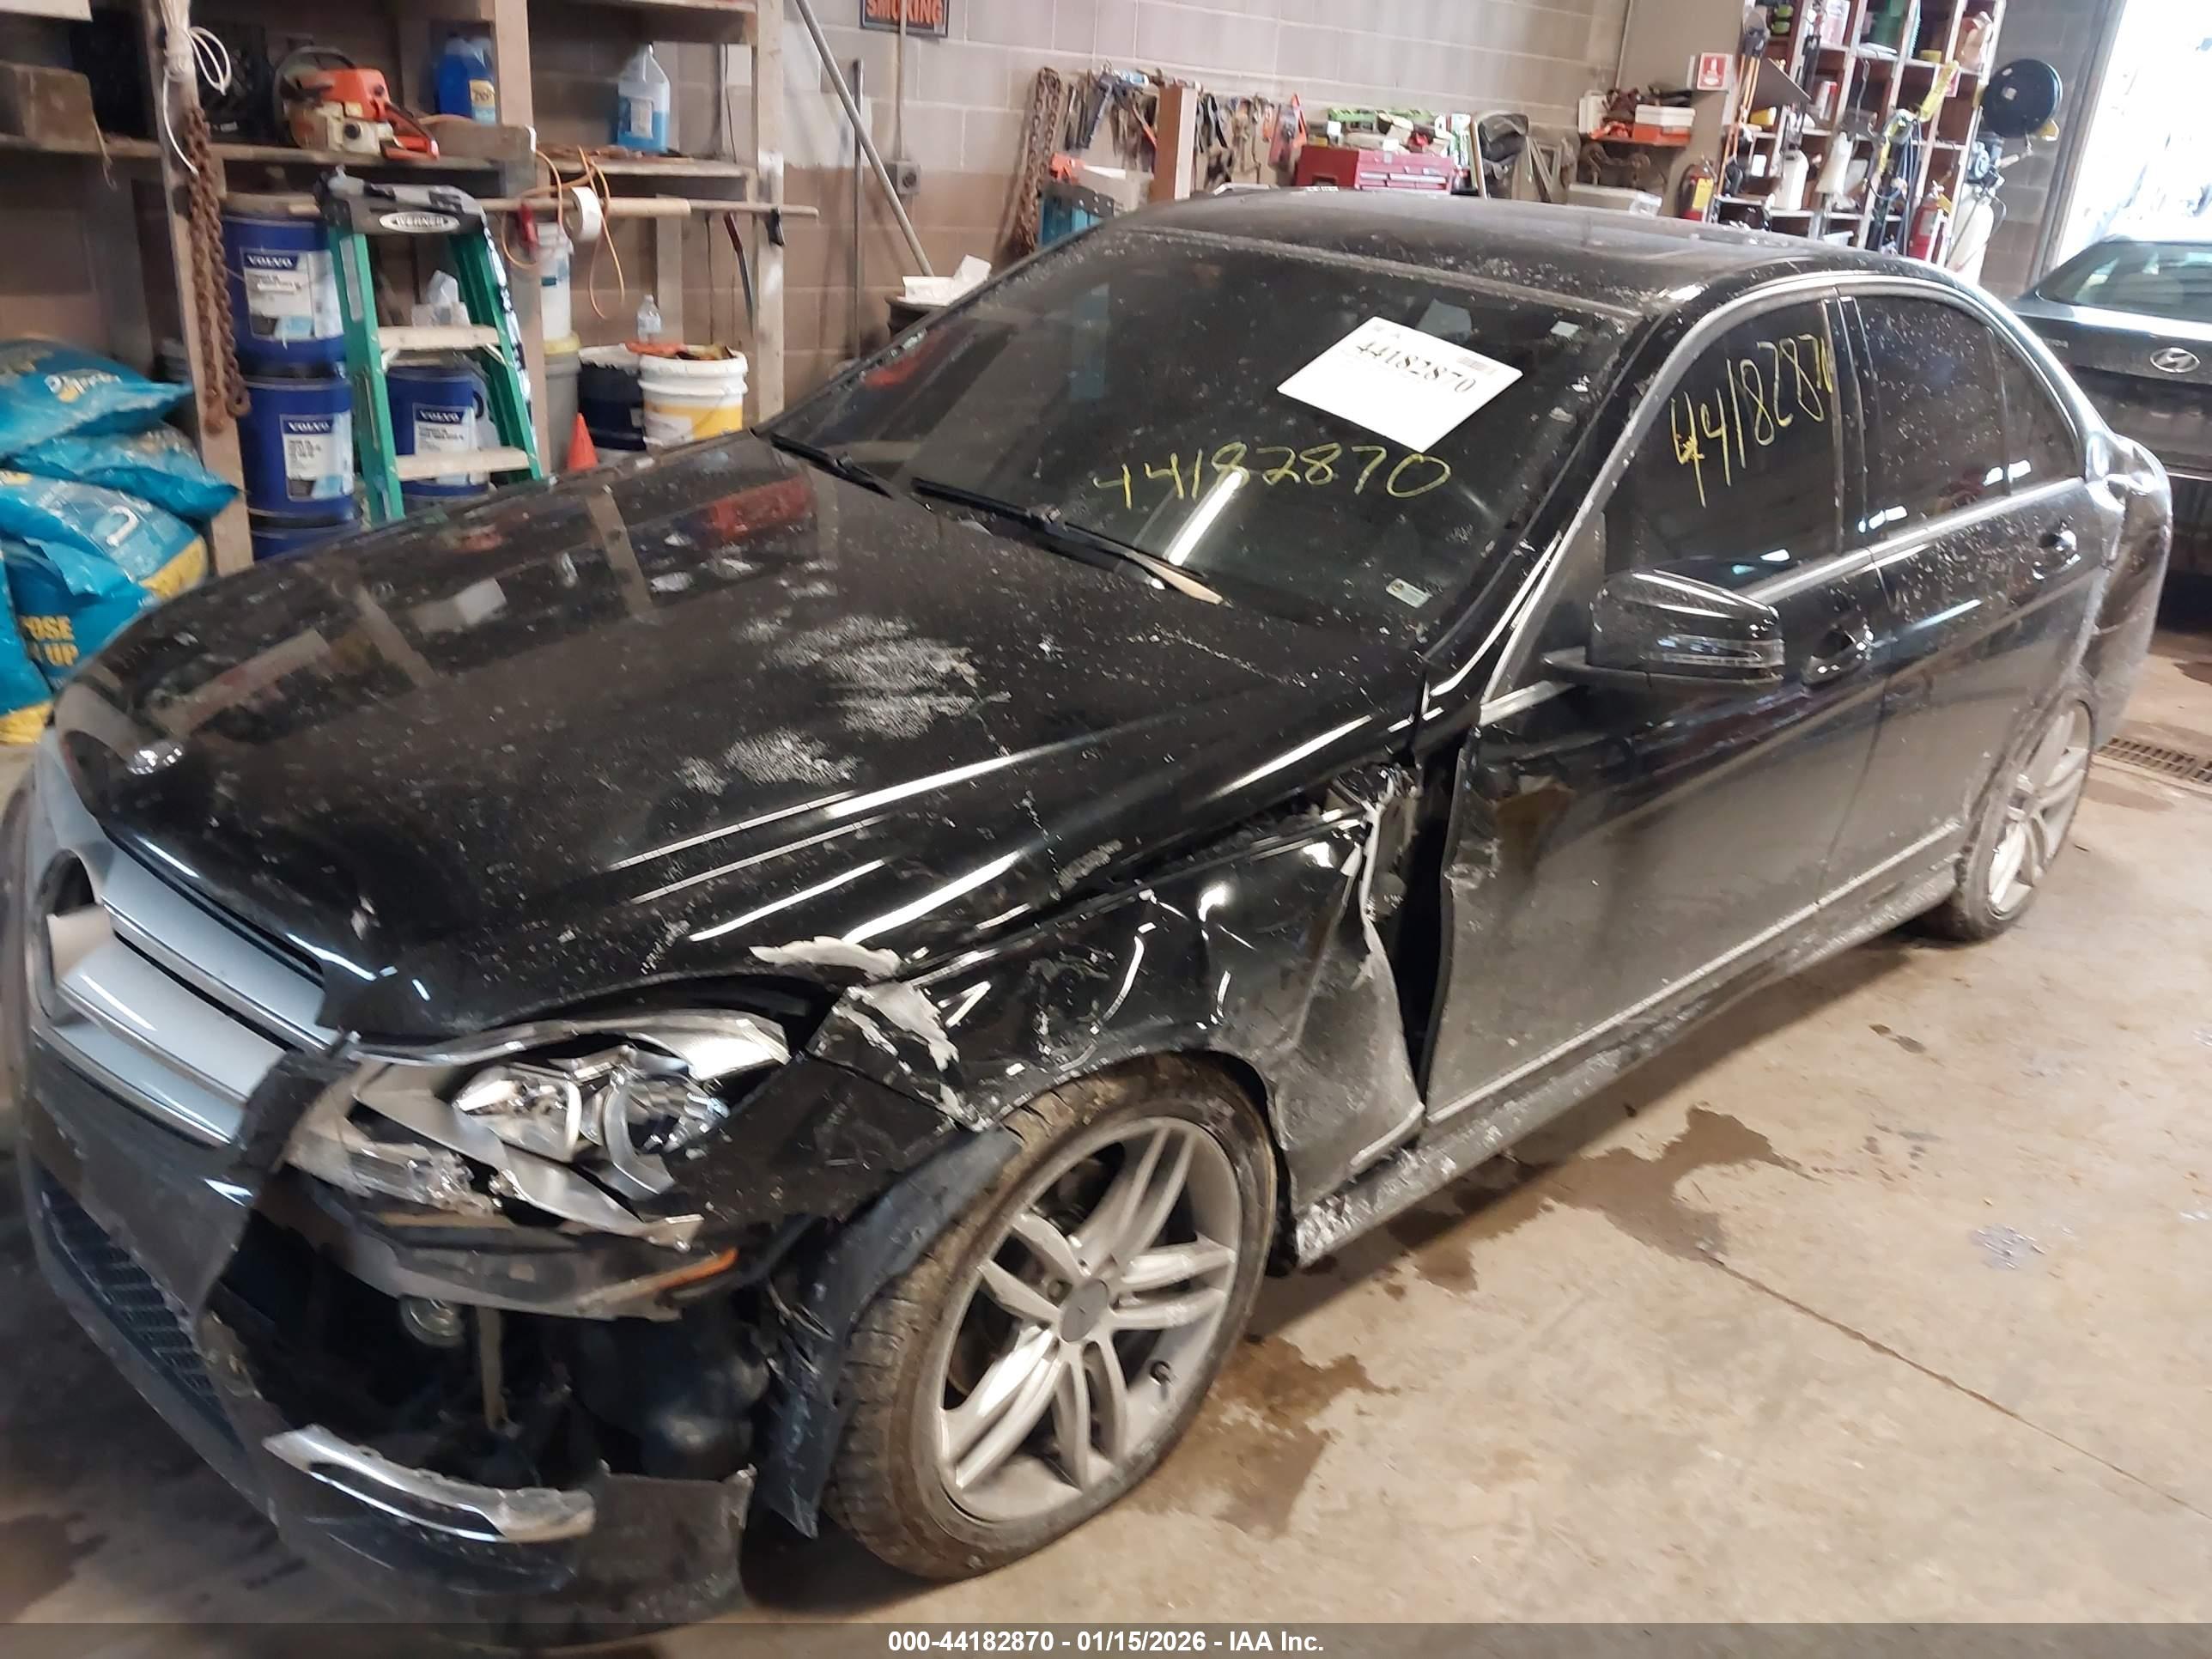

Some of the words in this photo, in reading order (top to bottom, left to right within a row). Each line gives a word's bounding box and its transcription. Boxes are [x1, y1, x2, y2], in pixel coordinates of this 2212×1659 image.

[866, 0, 944, 25] SMOKING
[246, 254, 293, 268] VOLVO
[1355, 341, 1477, 393] 44182870
[418, 409, 460, 423] VOLVO
[288, 421, 331, 432] VOLVO
